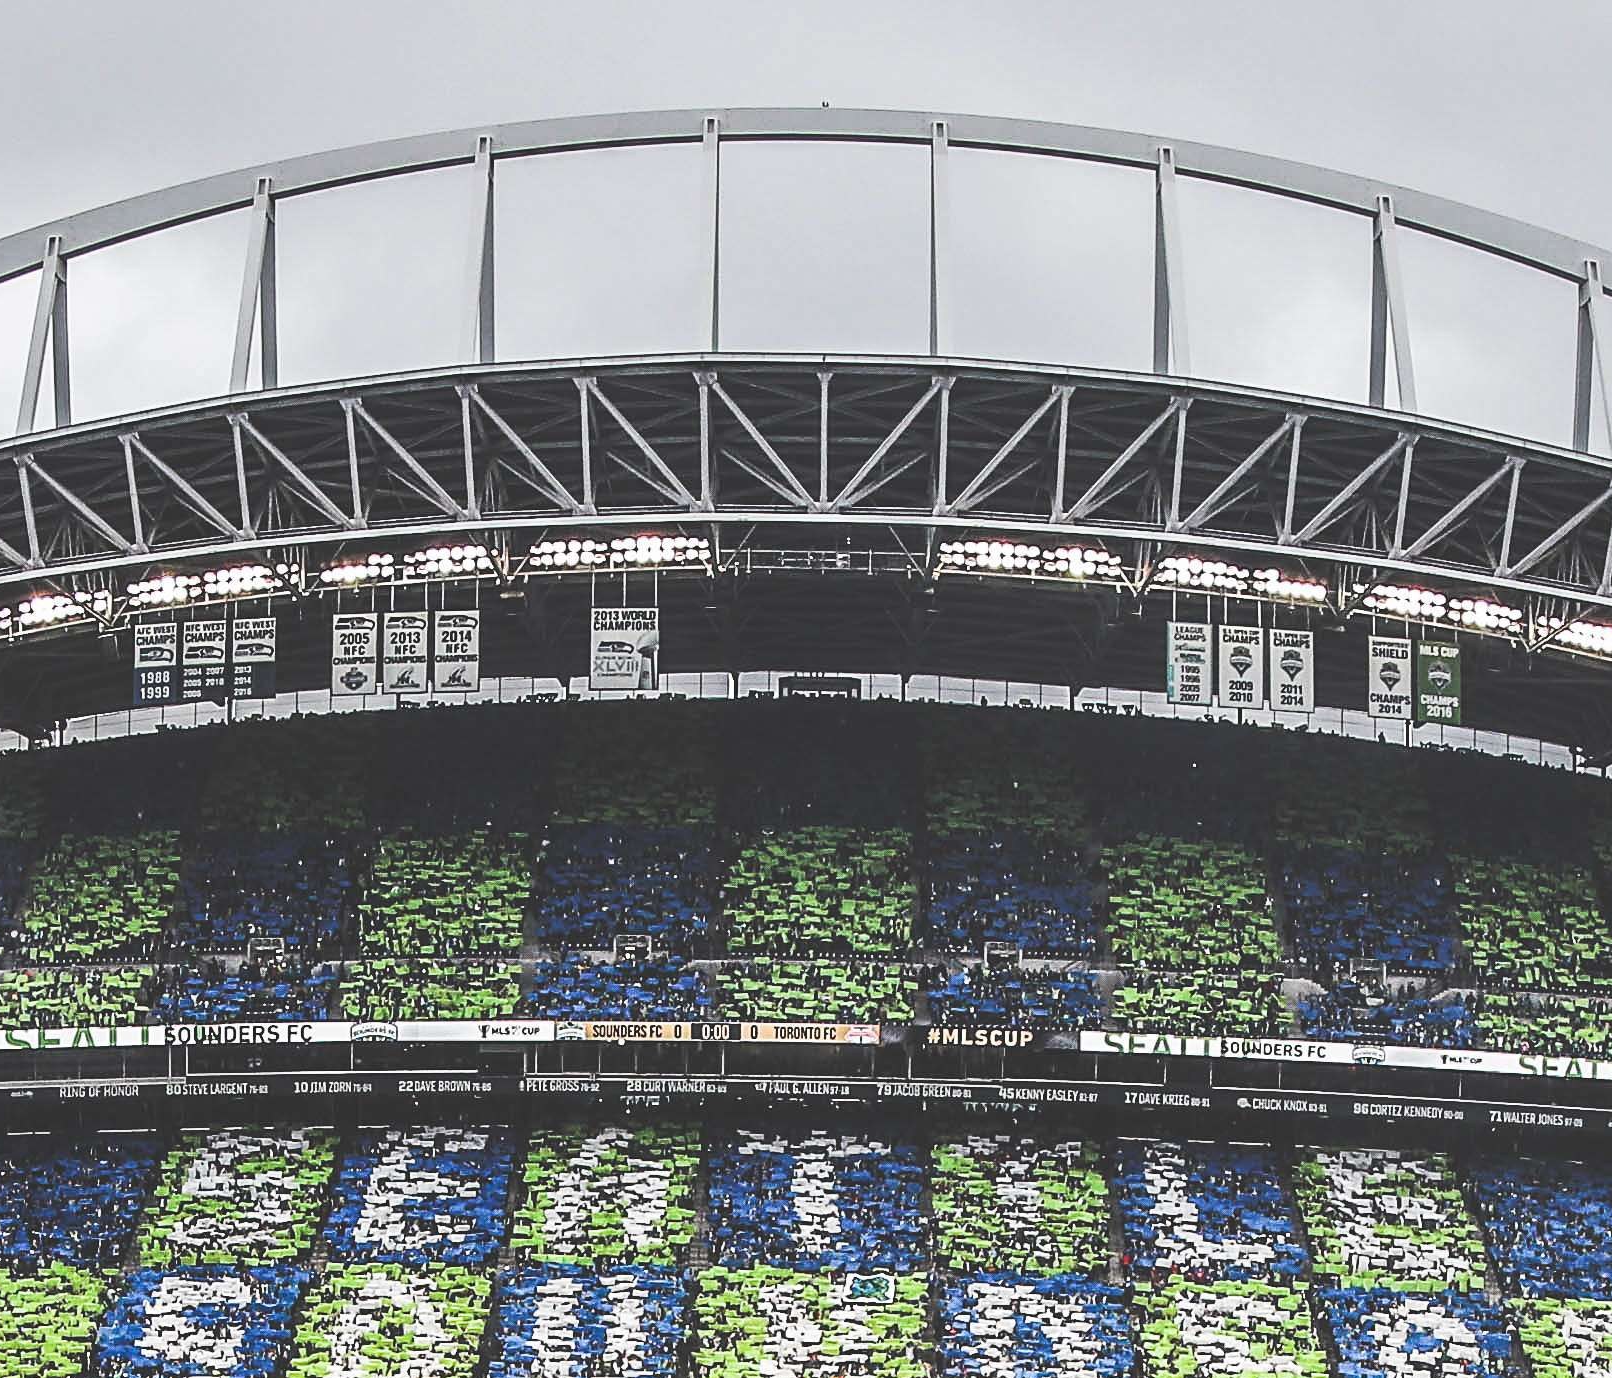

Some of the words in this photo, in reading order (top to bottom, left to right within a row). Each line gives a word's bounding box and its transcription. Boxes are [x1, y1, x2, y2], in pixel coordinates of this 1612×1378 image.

[594, 611, 619, 620] 2013
[622, 611, 656, 620] WORLD
[203, 622, 225, 631] WEST
[253, 620, 274, 628] WEST
[594, 621, 655, 631] CHAMPIONS
[137, 635, 175, 646] CHAMPS
[185, 632, 224, 642] CHAMPS
[235, 629, 274, 640] CHAMPS
[340, 633, 369, 645] 2005
[391, 632, 420, 644] 2013
[442, 631, 471, 642] 2014
[1174, 633, 1206, 642] CHAMPS
[1223, 635, 1259, 645] CHAMPS
[446, 644, 468, 653] NFC
[1274, 638, 1310, 648] CHAMPS
[344, 646, 365, 655] NFC
[395, 645, 416, 654] NFC
[1372, 647, 1408, 659] SHIELD
[1420, 645, 1438, 656] MLS
[1441, 646, 1459, 658] CUP
[141, 671, 170, 684] 1988
[1229, 681, 1253, 691] 2009
[1281, 684, 1303, 695] 2011
[141, 686, 170, 699] 1999
[1229, 692, 1252, 702] 2010
[1281, 695, 1303, 705] 2014
[1370, 693, 1410, 705] CHAMPS
[1421, 694, 1459, 707] CHAMPS
[1379, 704, 1401, 714] 2014
[1427, 706, 1452, 718] 2016
[165, 1025, 280, 1045] SOUNDERS
[288, 1024, 312, 1042] FC
[491, 1027, 510, 1035] MLS
[522, 1027, 540, 1035] CUP
[593, 1025, 647, 1039] SOUNDERS
[650, 1025, 662, 1039] FC
[674, 1025, 681, 1039] 0
[702, 1025, 730, 1039] 0:00
[750, 1026, 758, 1039] 0
[774, 1026, 820, 1040] TORONTO
[824, 1027, 836, 1040] FC
[926, 1028, 1033, 1047] #MLSCUP
[1220, 1039, 1303, 1058] SOUNDERS
[1308, 1045, 1326, 1059] FC
[60, 1086, 86, 1098] RING
[88, 1086, 101, 1097] OF
[103, 1085, 139, 1097] HONOR
[166, 1085, 181, 1096] 80
[183, 1084, 208, 1096] STEVE
[210, 1083, 248, 1095] LARGENT
[294, 1081, 308, 1093] 10
[310, 1082, 327, 1093] JIM
[328, 1082, 352, 1093] ZORN
[398, 1080, 414, 1092] 22
[414, 1081, 436, 1092] DAVE
[438, 1080, 471, 1092] BROWN
[526, 1081, 548, 1092] PETE
[549, 1080, 580, 1092] GROSS
[626, 1081, 642, 1092] 28
[643, 1081, 666, 1092] CURT
[668, 1082, 705, 1093] WARNER
[803, 1083, 830, 1095] ALLEN
[877, 1084, 892, 1096] 79
[893, 1084, 920, 1097] JACOB
[922, 1086, 951, 1097] GREEN
[998, 1088, 1015, 1099] 45
[1016, 1089, 1045, 1100] KENNY
[1047, 1089, 1078, 1102] EASLEY
[1125, 1092, 1138, 1103] 17
[1139, 1093, 1160, 1105] DAVE
[1162, 1094, 1190, 1106] KRIEG
[1253, 1098, 1281, 1110] CHUCK
[1283, 1100, 1308, 1112] KNOX
[1353, 1103, 1369, 1115] 96
[1370, 1103, 1402, 1117] CORTEZ
[1404, 1105, 1442, 1118] KENNEDY
[1490, 1110, 1502, 1122] 71
[1503, 1111, 1536, 1124] WALTER
[1537, 1112, 1564, 1126] JONES
